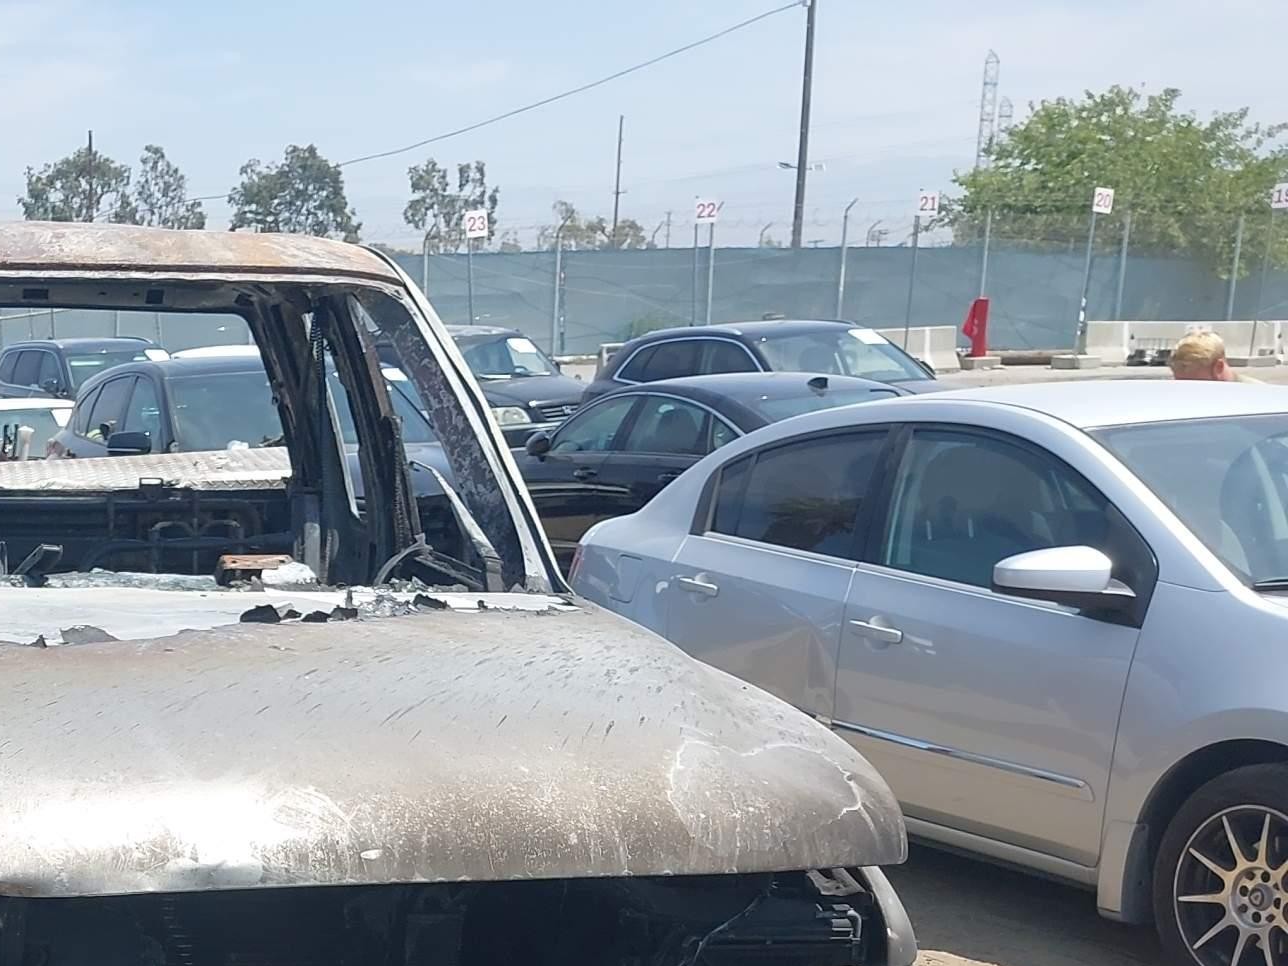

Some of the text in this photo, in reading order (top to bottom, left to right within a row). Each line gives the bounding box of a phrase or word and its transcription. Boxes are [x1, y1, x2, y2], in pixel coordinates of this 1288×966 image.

[919, 195, 936, 211] 21
[1095, 192, 1112, 209] 20
[696, 202, 716, 219] 22
[467, 215, 486, 232] 23
